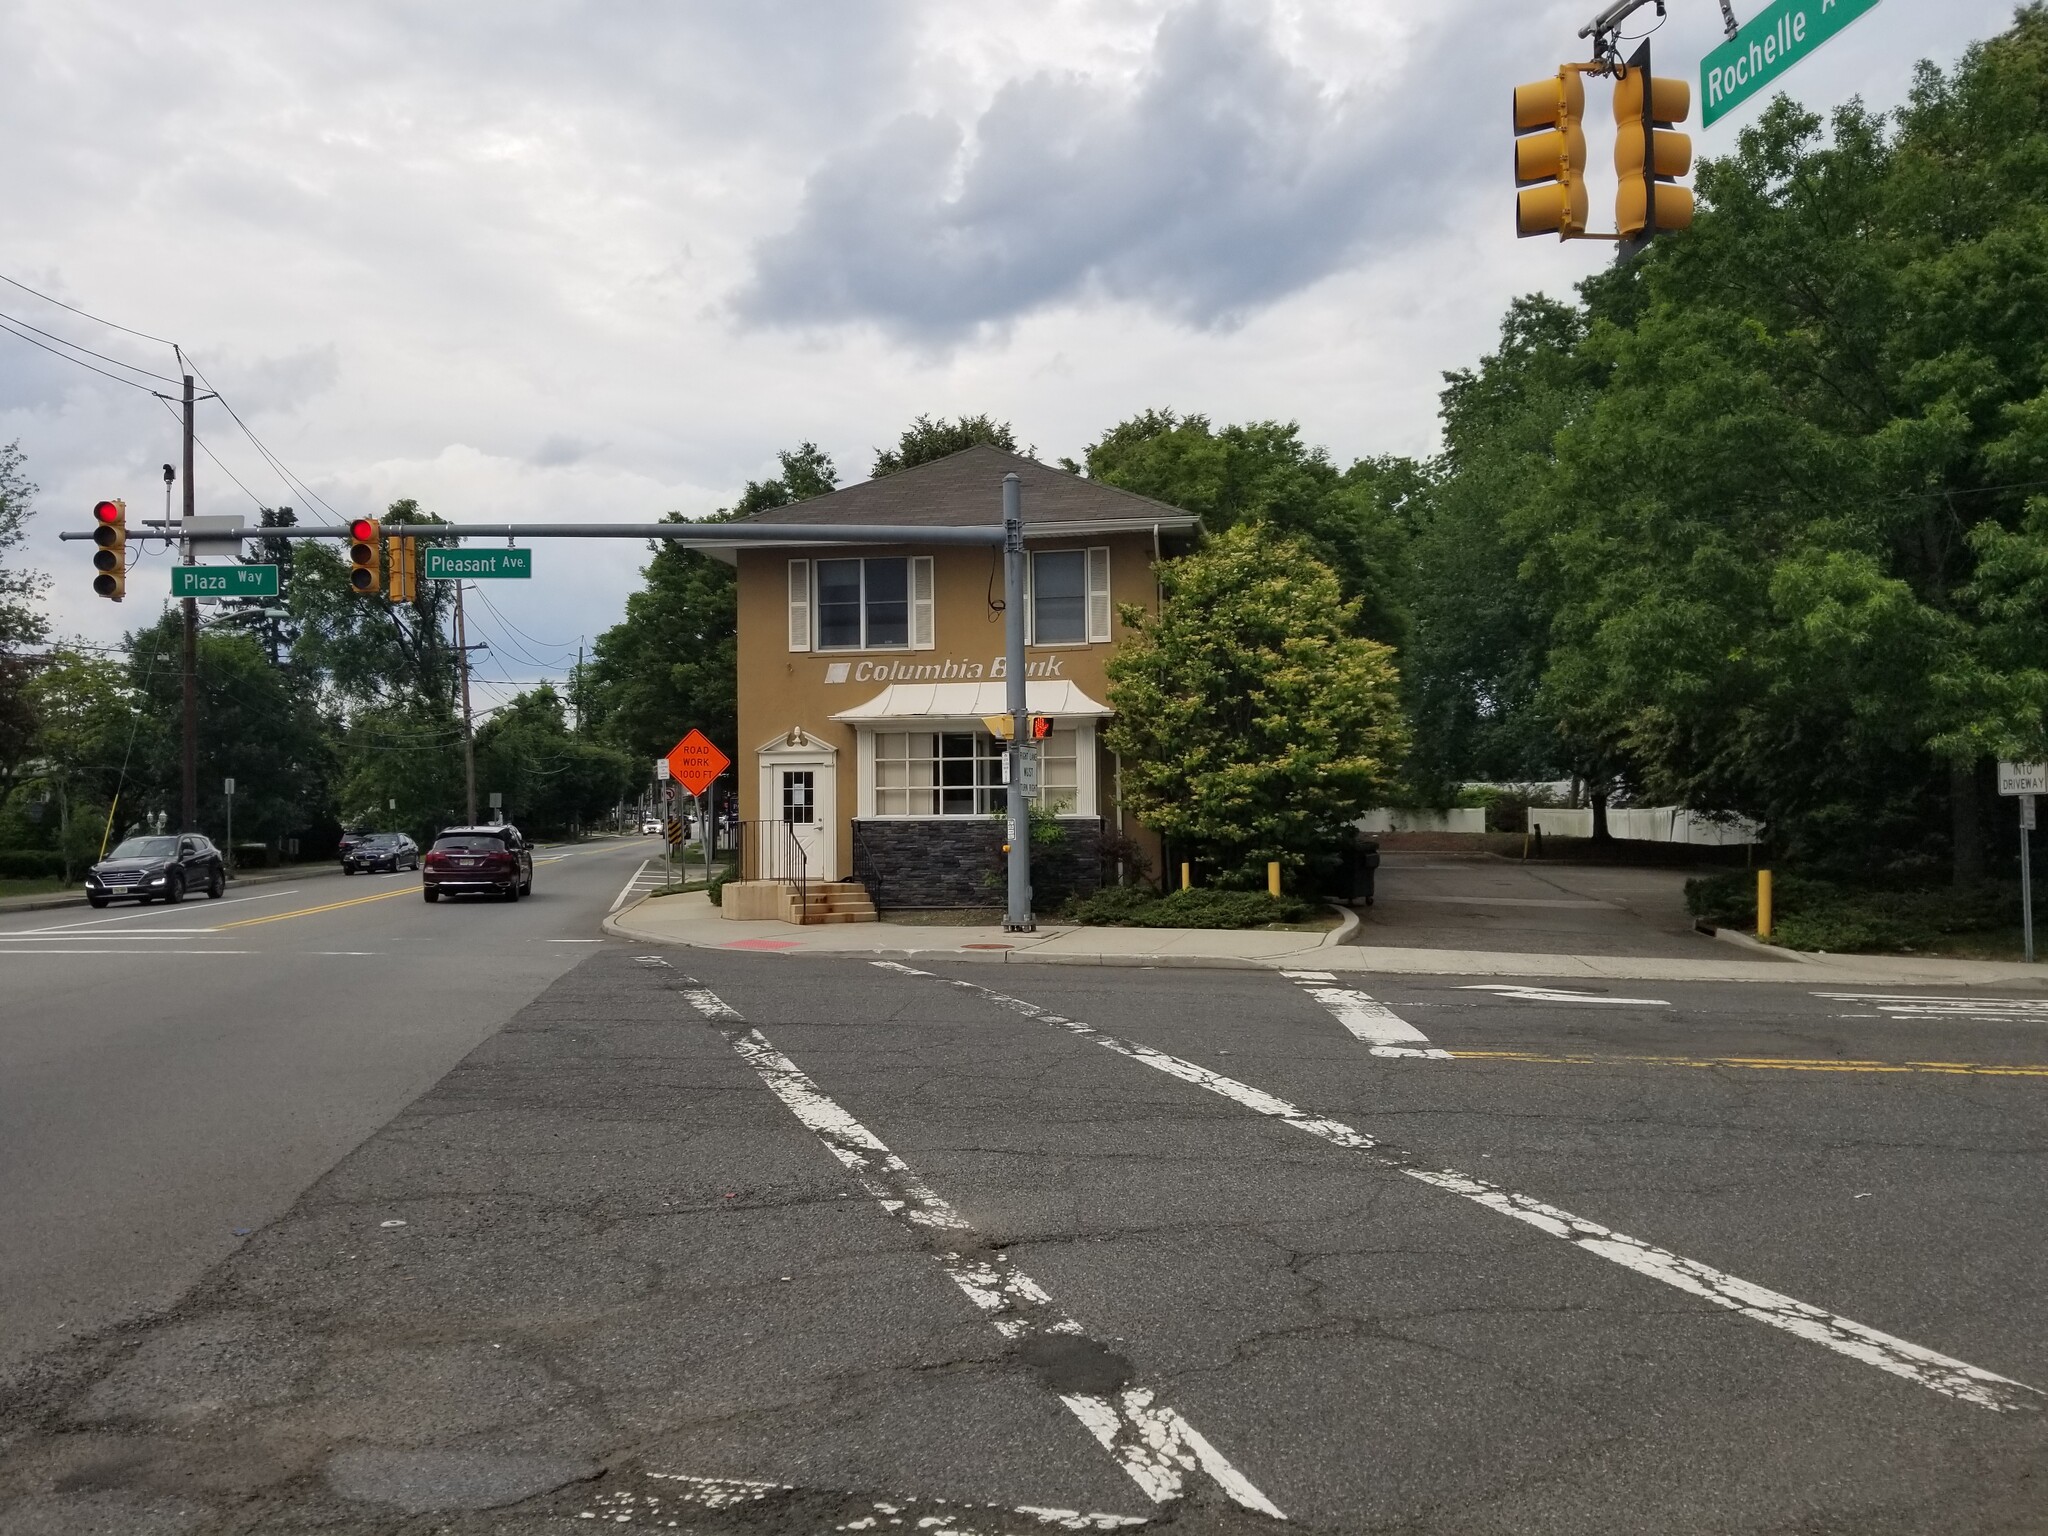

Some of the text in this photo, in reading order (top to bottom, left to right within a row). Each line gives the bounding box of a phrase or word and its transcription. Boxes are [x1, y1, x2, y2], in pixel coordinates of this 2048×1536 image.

[1708, 11, 1806, 108] Rochelle
[431, 556, 526, 572] Pleasant Ave.
[184, 570, 262, 590] Plaza Way
[855, 655, 1064, 682] Columbia Bnk
[683, 746, 709, 754] ROAD
[683, 758, 709, 766] WORK
[680, 770, 701, 779] 1000
[702, 770, 712, 779] FT
[1023, 767, 1034, 777] MUST
[2013, 764, 2032, 775] INTO
[2003, 778, 2044, 790] DRIVEWAY
